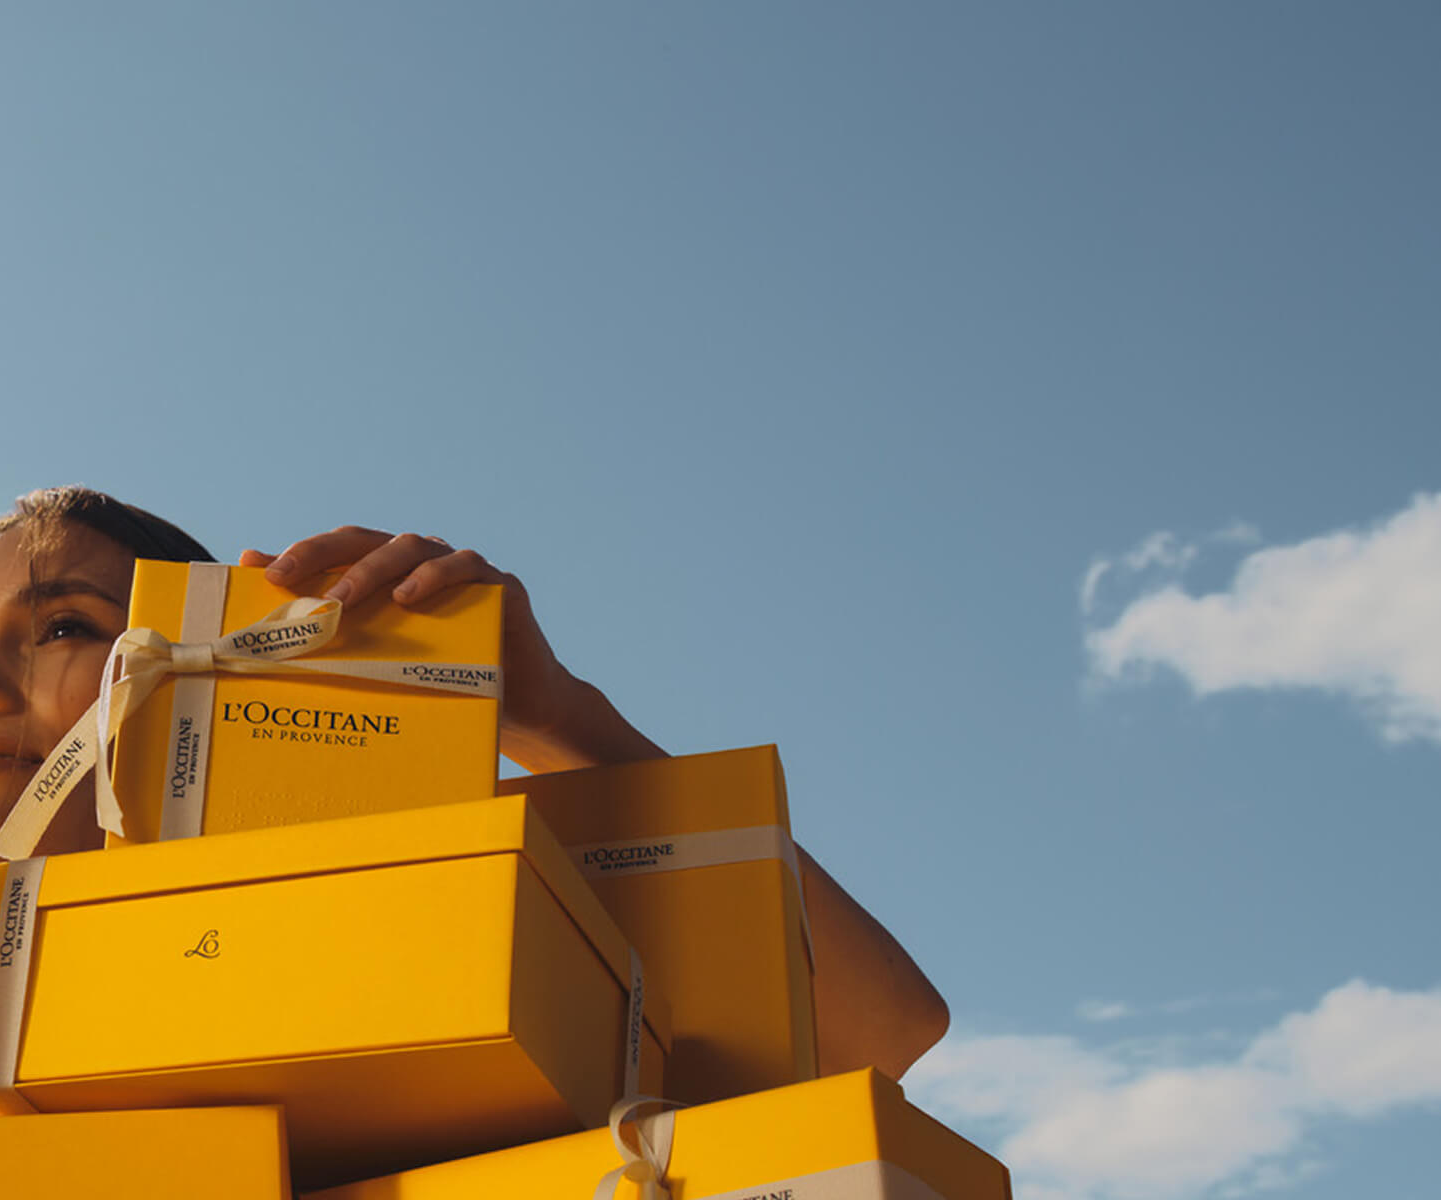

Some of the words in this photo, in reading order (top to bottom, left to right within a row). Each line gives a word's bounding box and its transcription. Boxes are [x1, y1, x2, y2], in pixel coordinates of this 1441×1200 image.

[232, 622, 323, 649] L'OCCITANE
[402, 665, 497, 682] L'OCCITANE
[222, 701, 400, 735] L'OCCITANE
[251, 728, 273, 739] EN
[280, 729, 368, 747] PROVENCE
[34, 737, 86, 802] L'OCCITANE
[171, 716, 192, 798] L'OCCITANE
[584, 843, 674, 865] L'OCCITANE
[0, 877, 25, 968] L'OCCITANE
